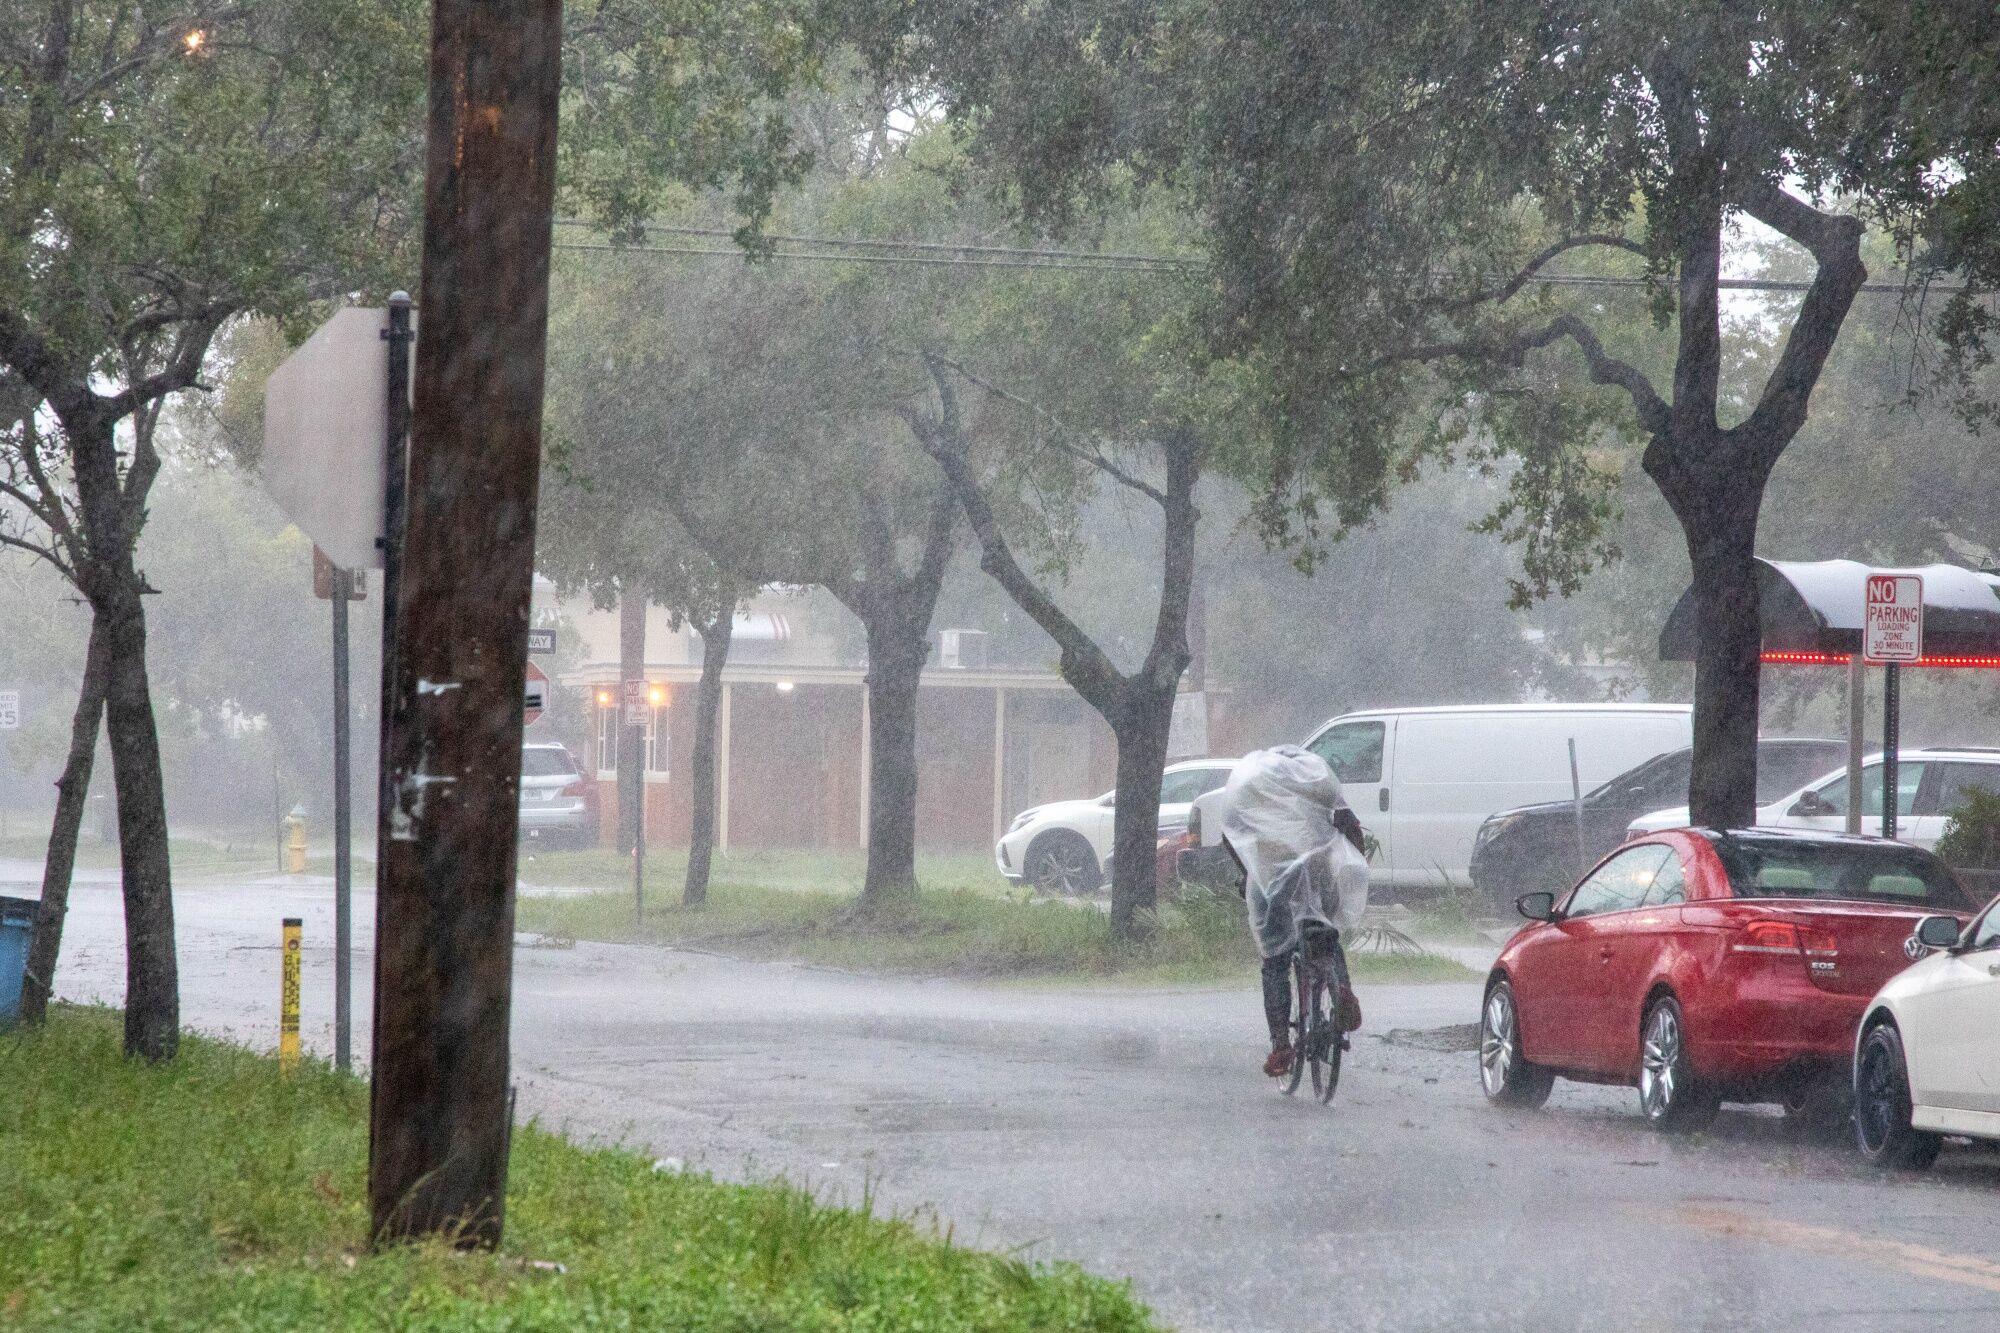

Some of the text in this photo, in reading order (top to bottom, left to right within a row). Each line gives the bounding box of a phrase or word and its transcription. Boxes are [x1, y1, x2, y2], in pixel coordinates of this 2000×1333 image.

[1869, 580, 1895, 602] NO
[1869, 606, 1918, 623] PARKING
[1877, 622, 1910, 631] LOADING
[1883, 632, 1903, 641] ZONE
[1874, 641, 1914, 650] 30 MINUTE
[0, 694, 17, 702] EED
